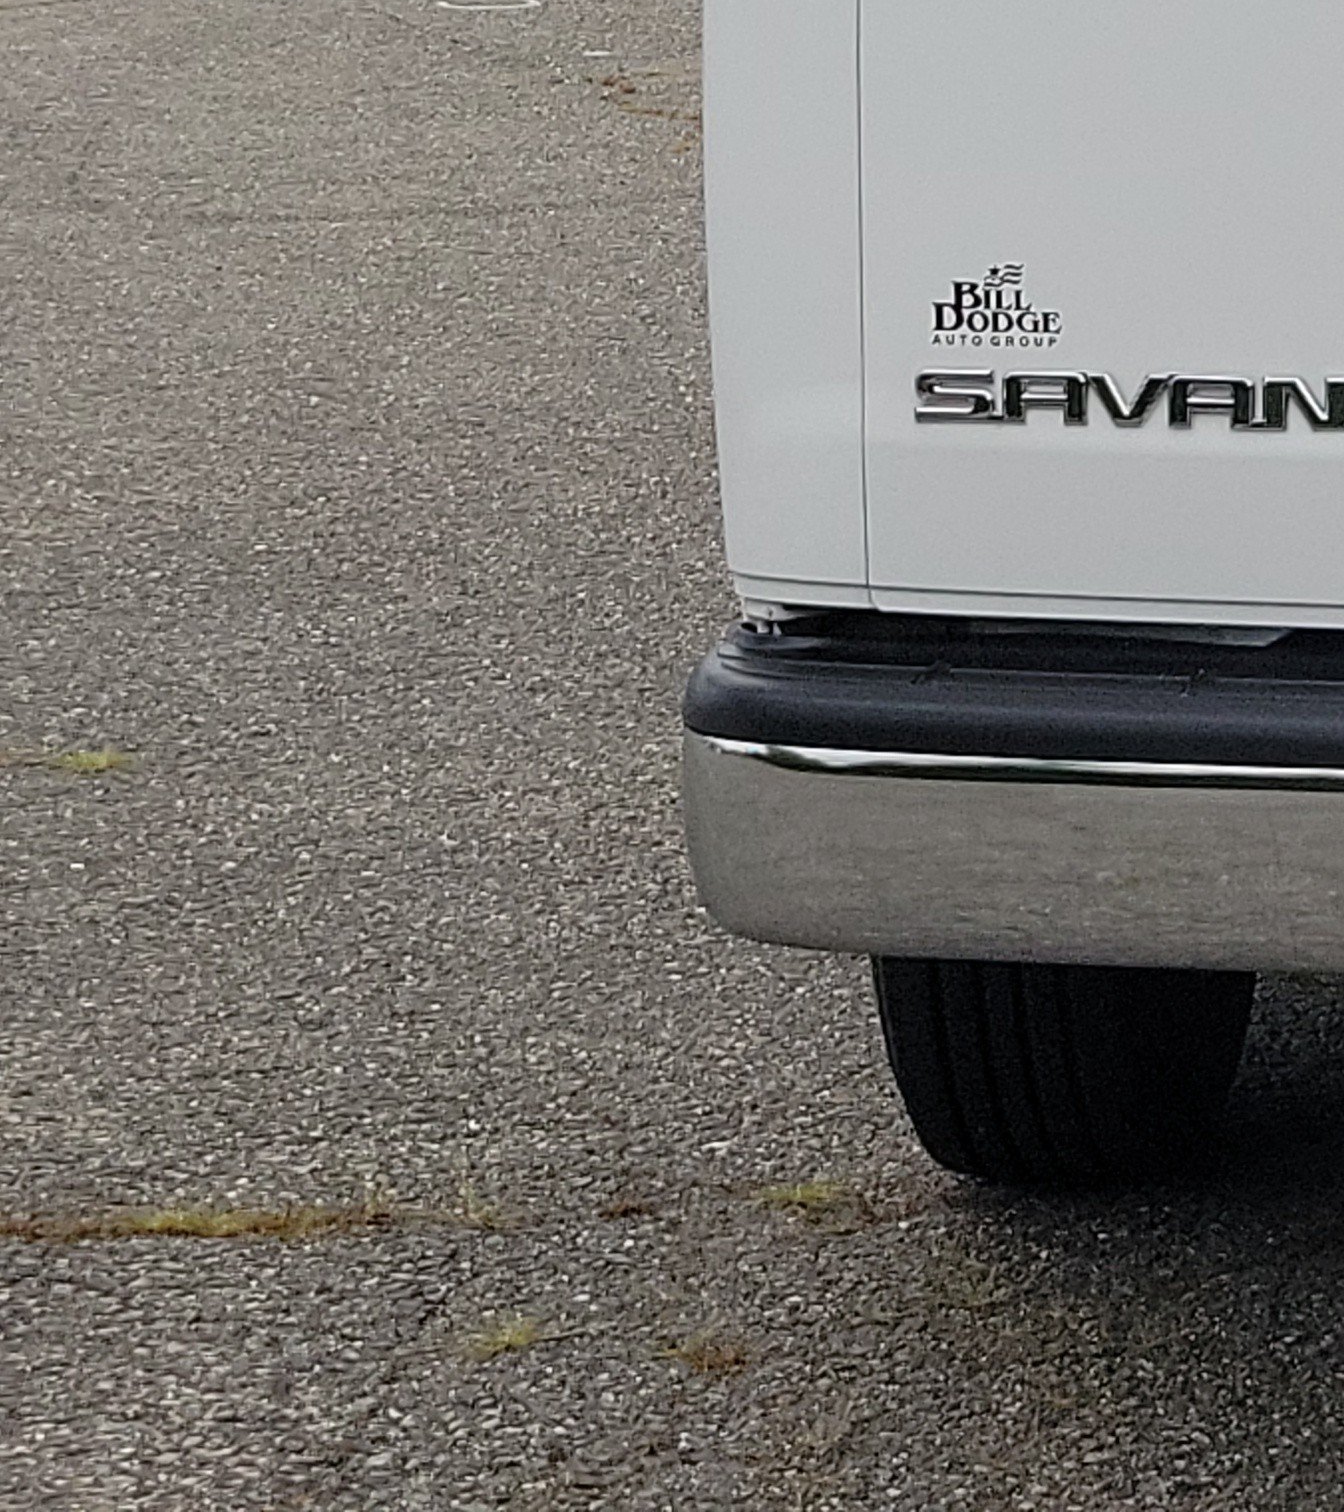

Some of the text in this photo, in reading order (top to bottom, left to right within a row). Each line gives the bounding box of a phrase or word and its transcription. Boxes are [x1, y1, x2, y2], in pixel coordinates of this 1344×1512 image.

[952, 280, 1031, 311] BILL
[932, 302, 1062, 334] DODGE
[931, 334, 1057, 347] AUTO GROUP
